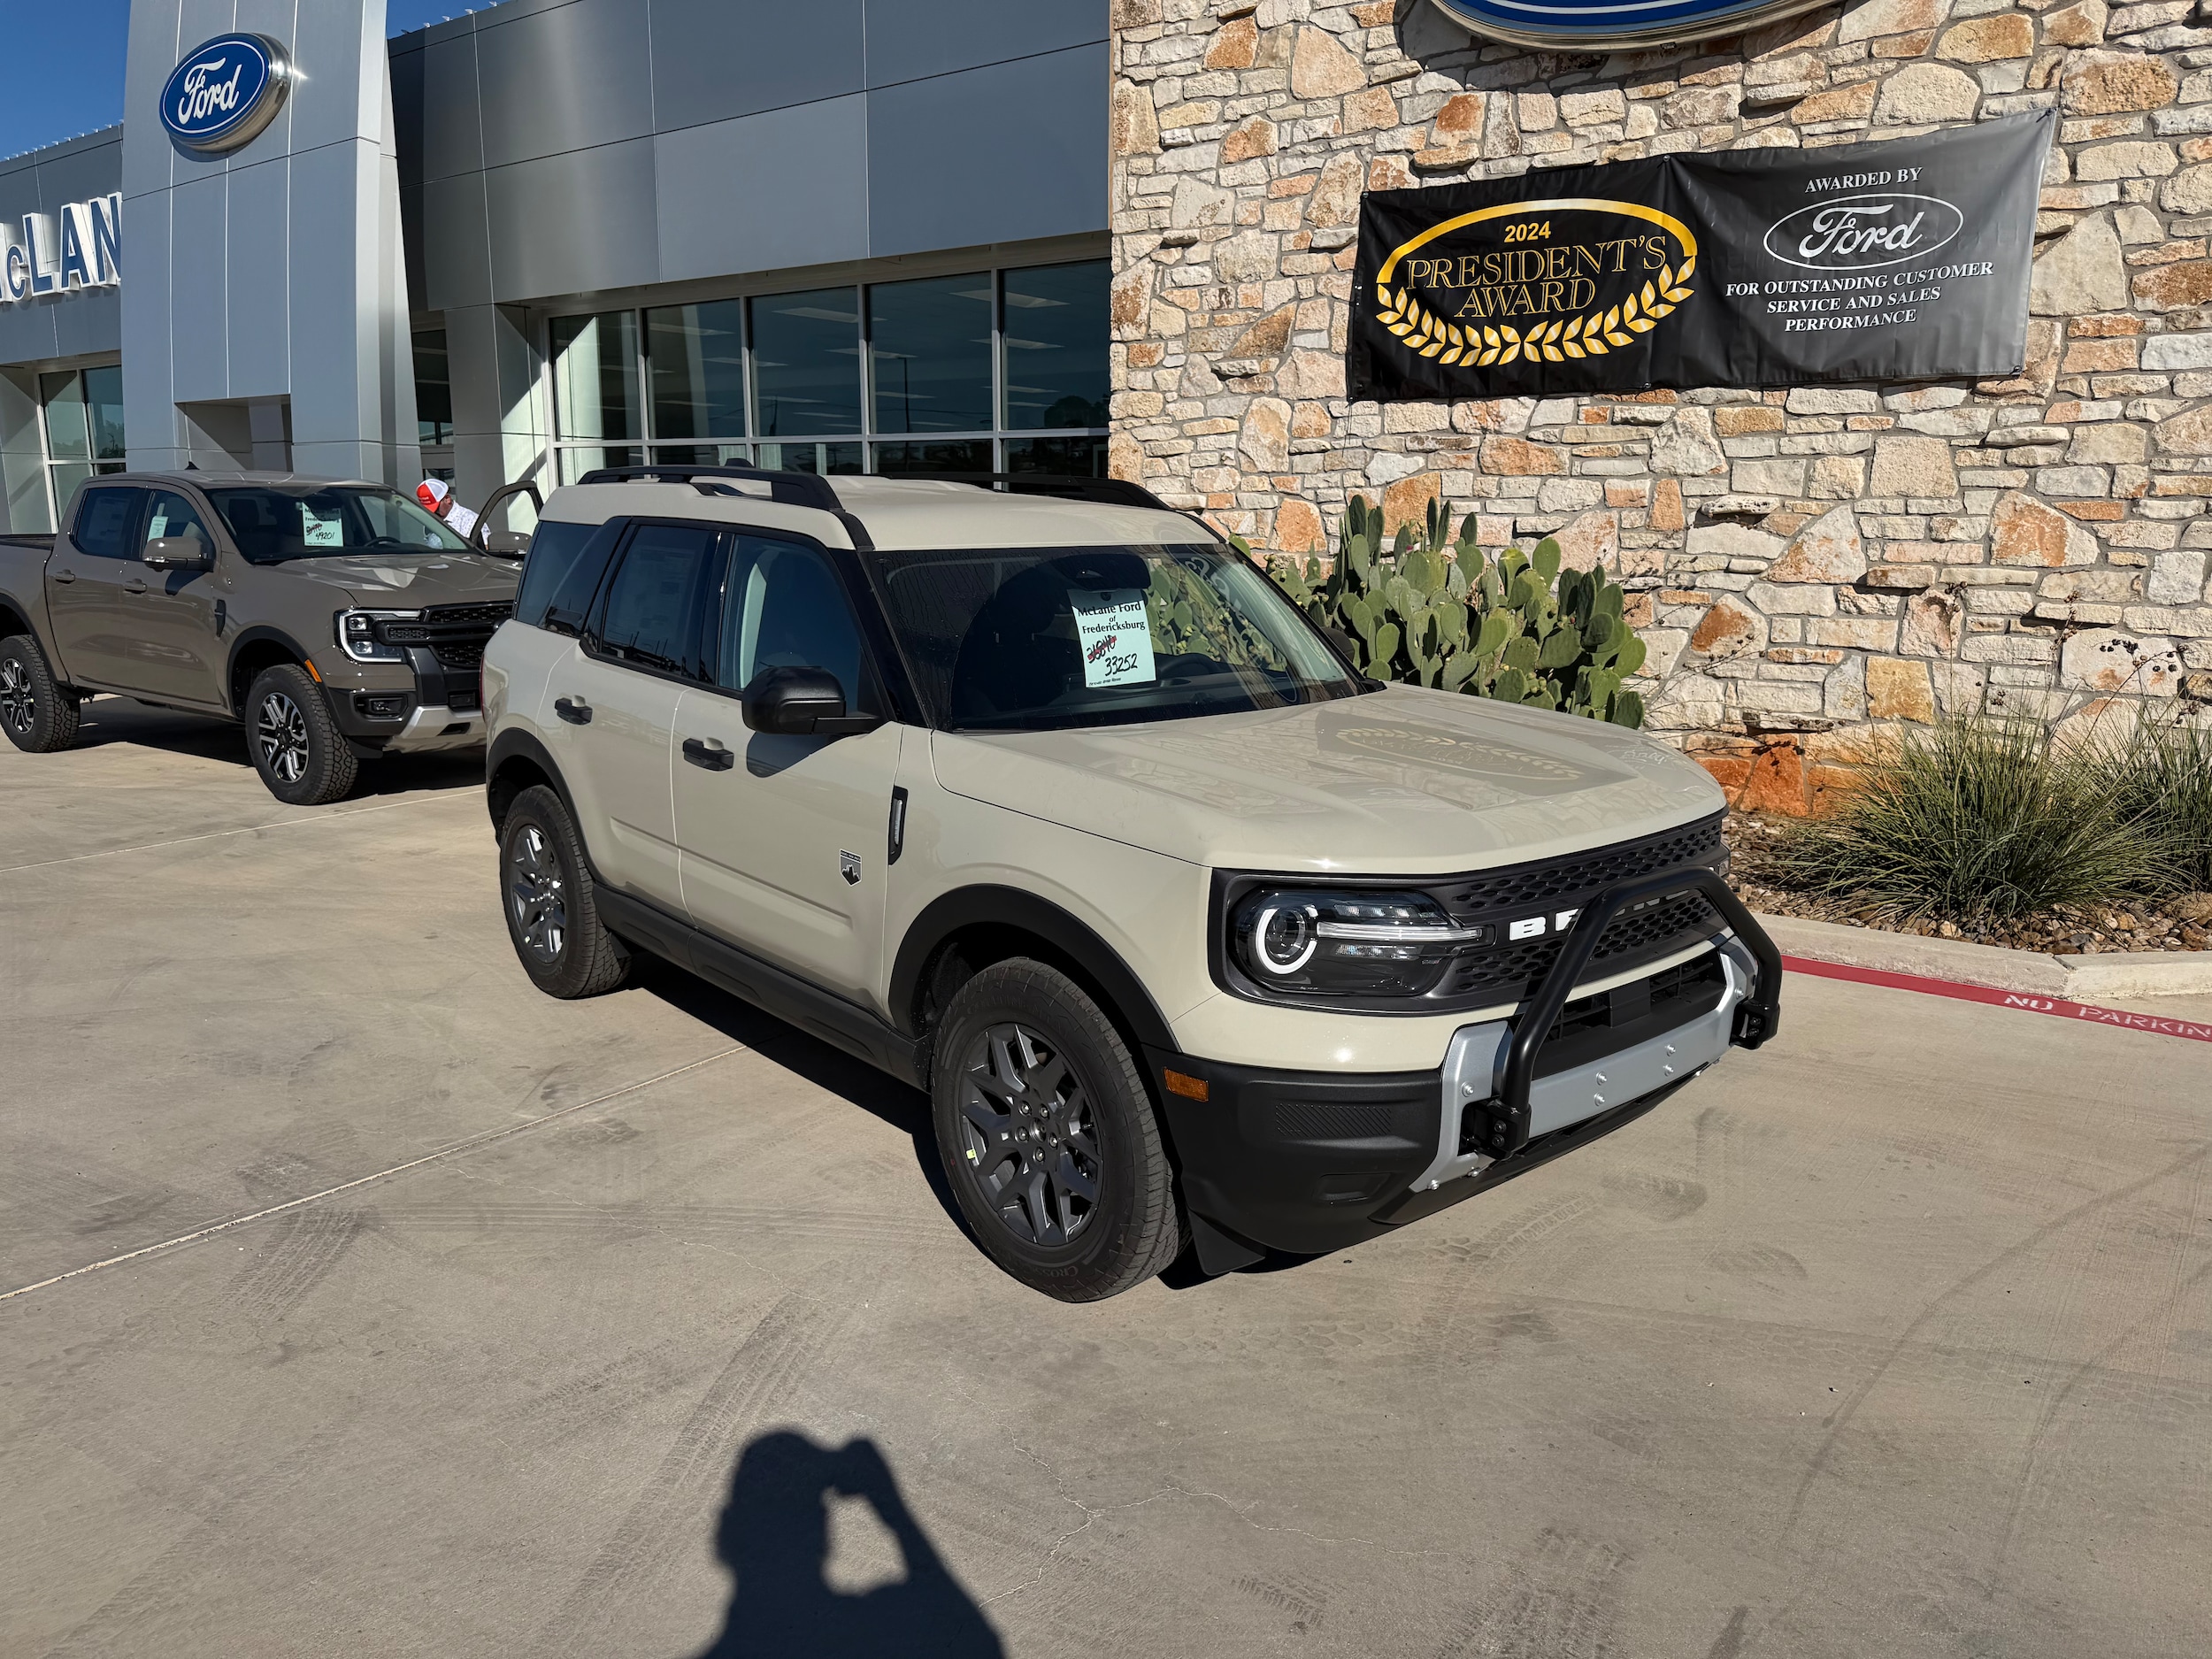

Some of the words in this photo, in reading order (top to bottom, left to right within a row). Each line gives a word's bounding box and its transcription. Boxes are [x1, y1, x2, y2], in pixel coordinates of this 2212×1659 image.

[178, 58, 242, 125] Ford
[1804, 170, 1892, 194] AWARDED
[1896, 166, 1924, 184] BY
[1503, 220, 1551, 243] 2024
[1798, 204, 1925, 258] Ford
[1406, 235, 1666, 290] PRESIDENT'S
[1725, 282, 1760, 297] FOR
[1763, 274, 1889, 295] OUTSTANDING
[1893, 261, 1994, 287] CUSTOMER
[1454, 278, 1596, 318] AWARD
[1766, 296, 1841, 314] SERVICE
[1845, 294, 1884, 311] AND
[1886, 286, 1942, 307] SALES
[1784, 309, 1917, 333] PERFORMANCE
[1109, 614, 1117, 623] of
[1118, 601, 1141, 613] Ford
[1081, 620, 1146, 634] Fredericksburg
[1104, 652, 1139, 677] 33252
[2003, 995, 2054, 1010] NO
